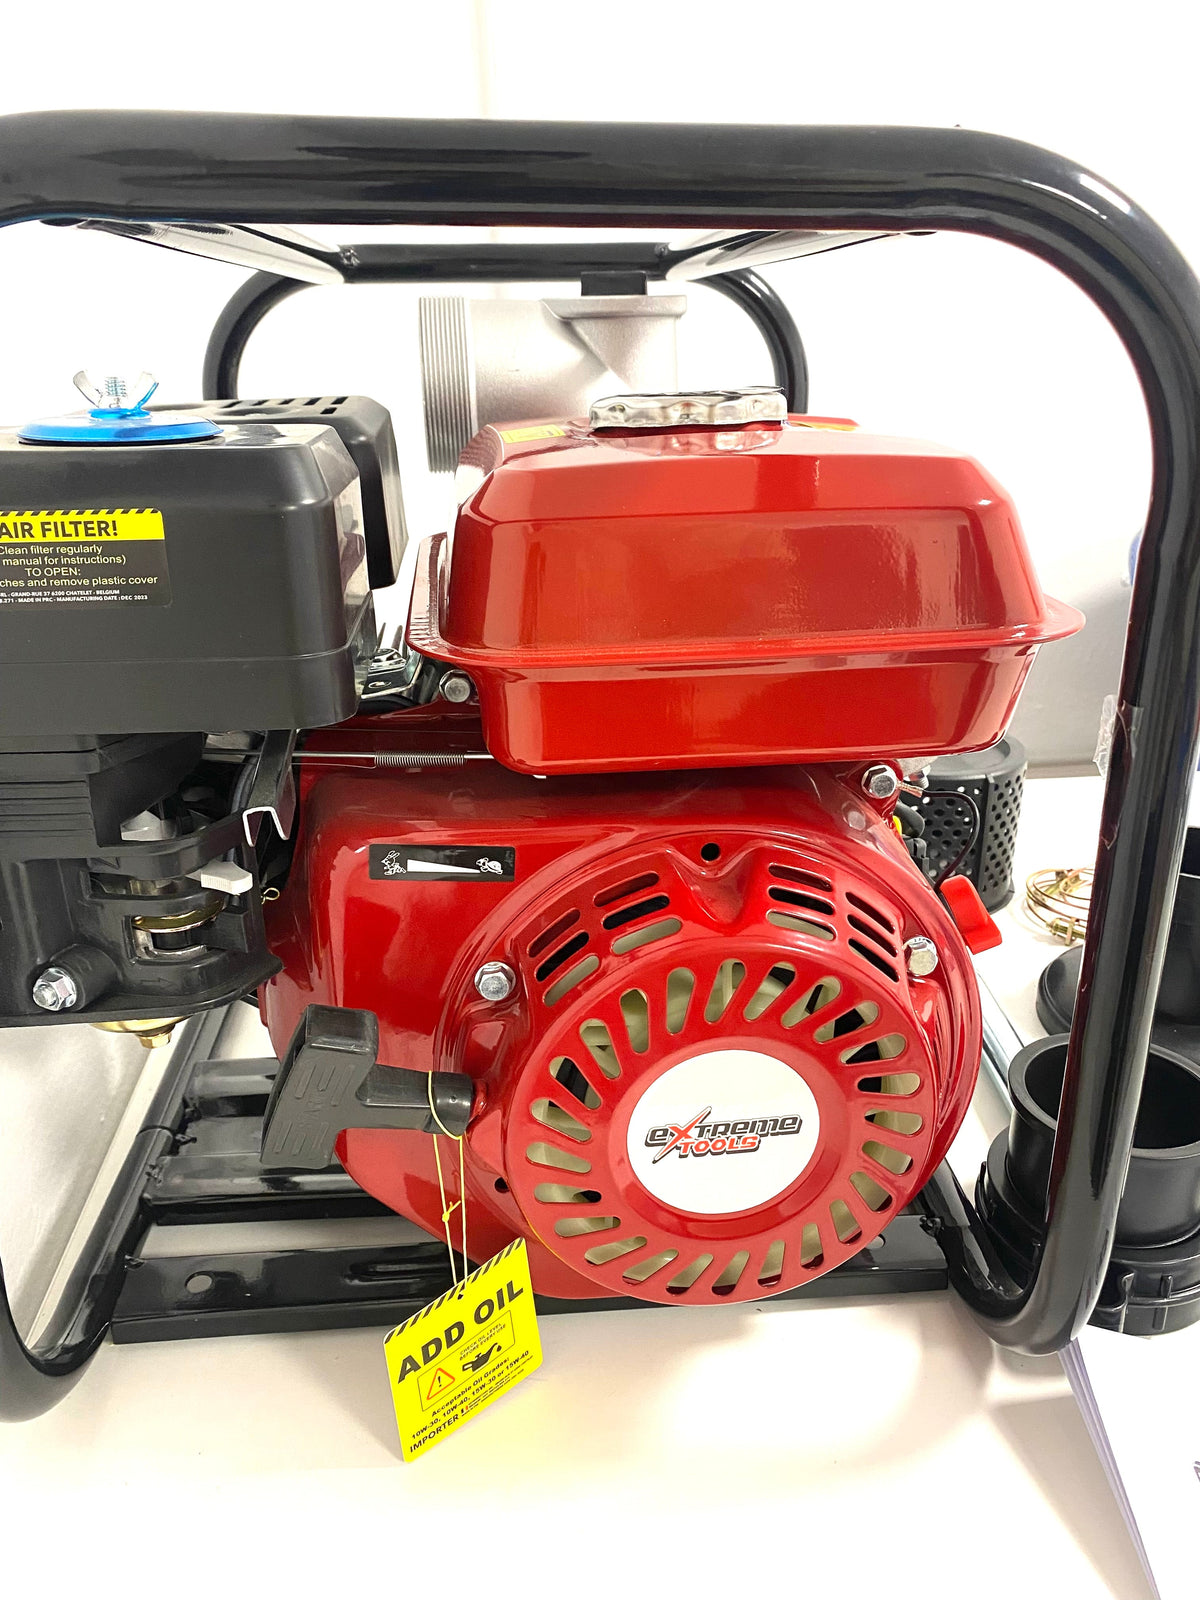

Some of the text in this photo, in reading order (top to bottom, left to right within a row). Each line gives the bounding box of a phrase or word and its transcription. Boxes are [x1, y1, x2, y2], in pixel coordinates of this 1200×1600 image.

[0, 520, 118, 538] AIR FILTER!
[0, 544, 103, 556] Clean filter regularly
[3, 554, 126, 566] manual for instructions)
[25, 567, 81, 577] TO OPEN:
[27, 577, 47, 587] and
[50, 578, 89, 587] remove
[92, 576, 126, 587] plastic
[128, 576, 158, 585] cover
[678, 1135, 762, 1159] TOOLS
[398, 1280, 524, 1384] ADD OIL
[412, 1350, 530, 1440] 10W-30, 10W-40, 15W-30 or 15W-40
[431, 1385, 472, 1417] Acceptable
[473, 1376, 483, 1387] Oil
[410, 1413, 460, 1453] IMPORTER
